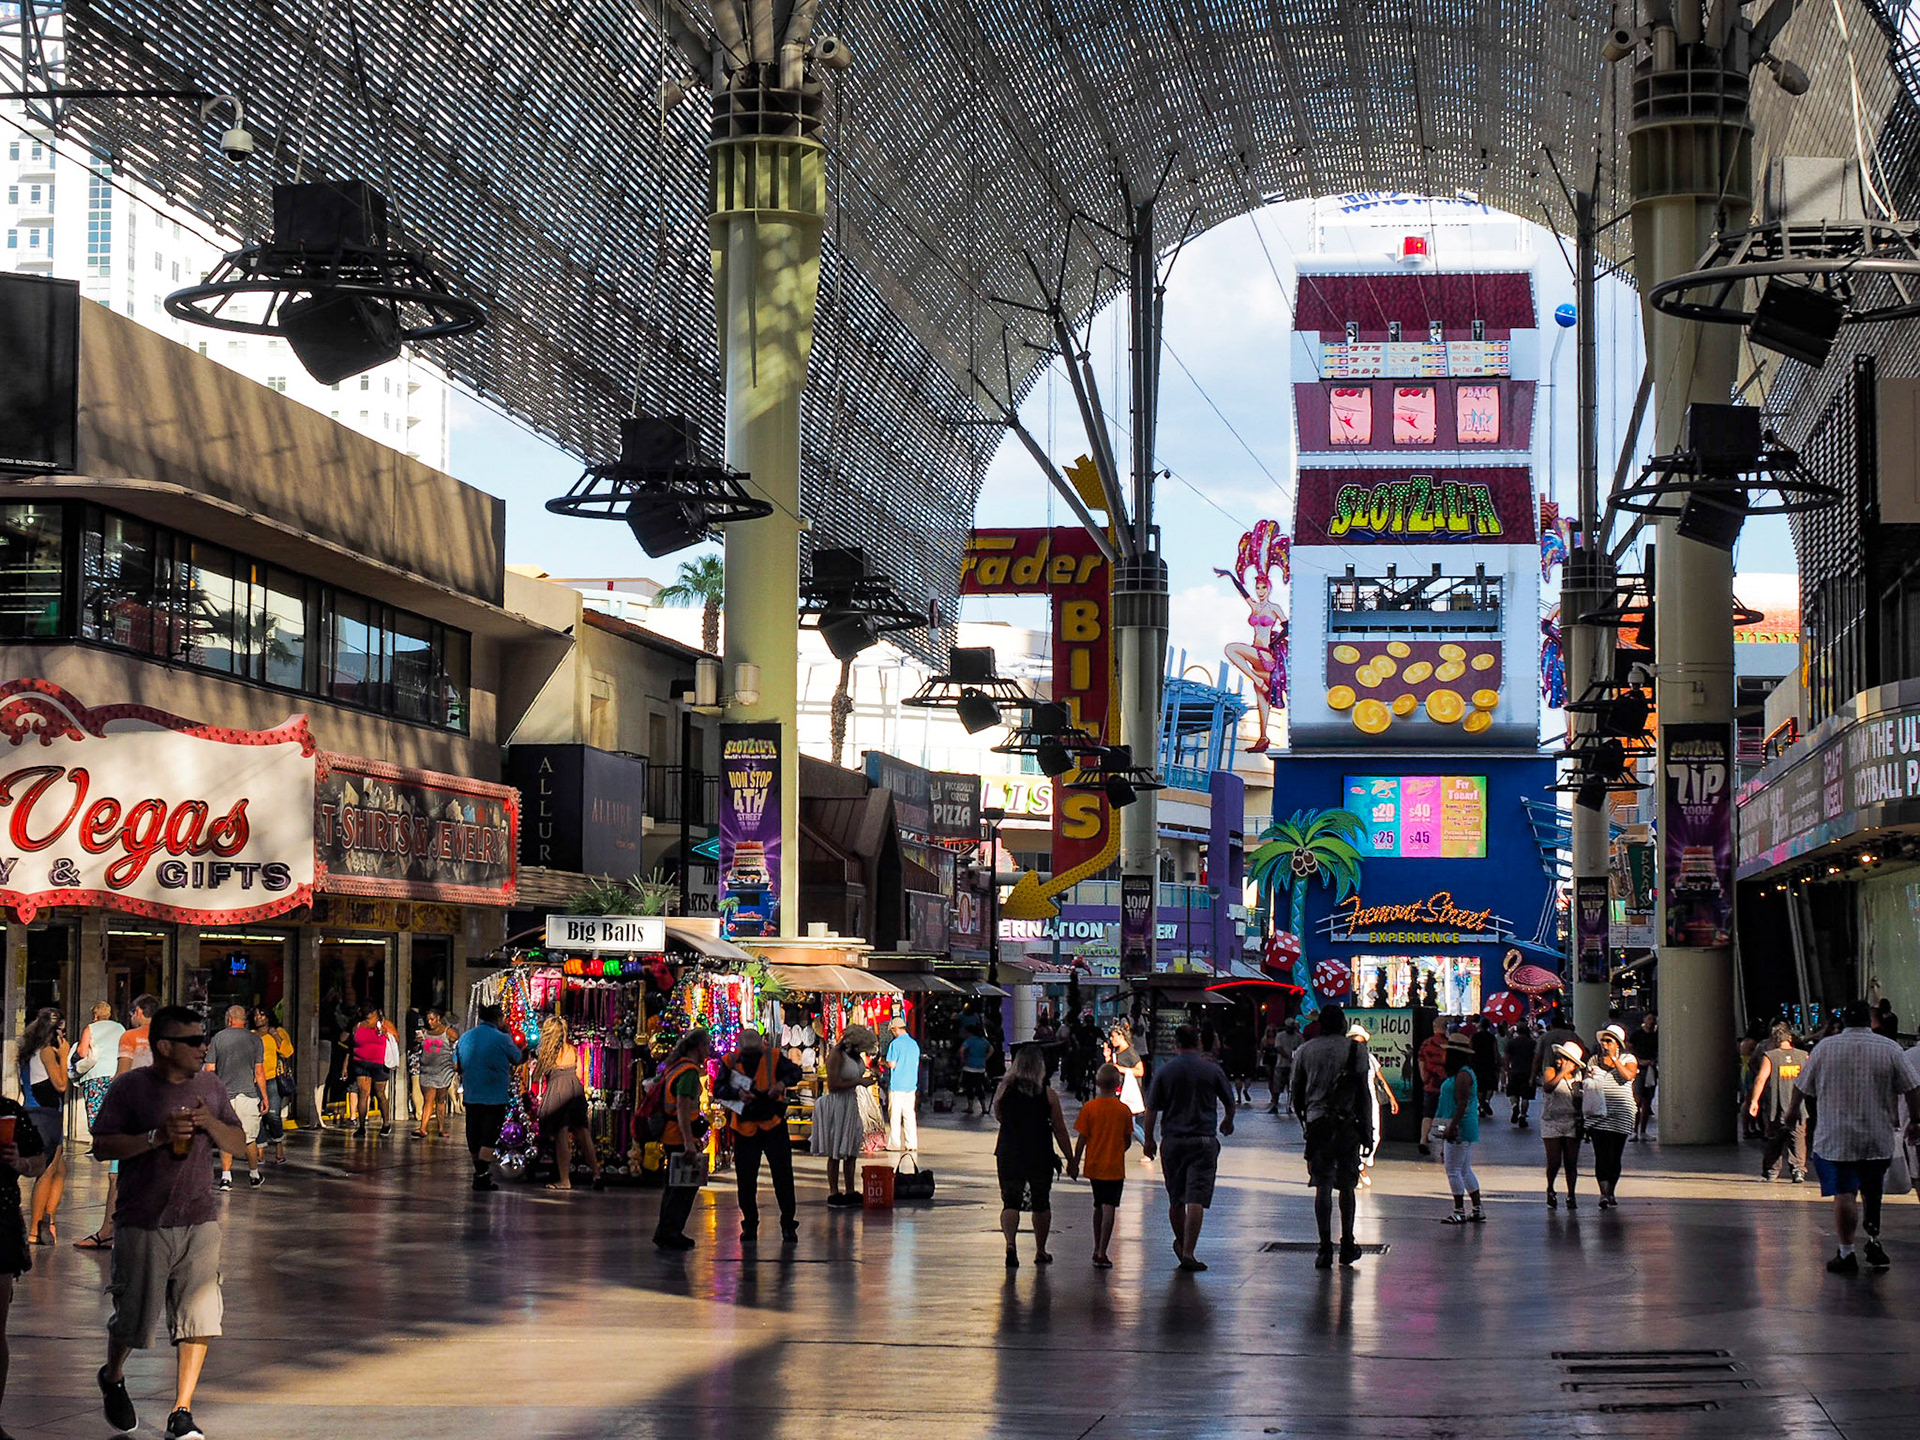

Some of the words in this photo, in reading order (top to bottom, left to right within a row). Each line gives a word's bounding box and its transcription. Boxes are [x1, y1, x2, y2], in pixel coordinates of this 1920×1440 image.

[1466, 415, 1489, 431] BAR
[1327, 475, 1503, 536] SLOTZILLA
[1870, 720, 1894, 759] THE
[1898, 714, 1920, 755] UL
[728, 771, 748, 788] NON
[750, 771, 772, 788] STOP
[945, 781, 975, 793] PICCADILLY
[734, 788, 768, 813] 4TH
[950, 792, 969, 802] CIRCUS
[737, 813, 762, 821] STREET
[934, 804, 971, 827] PIZZA
[1372, 803, 1395, 817] $20
[1409, 803, 1431, 817] $40
[0, 765, 249, 890] Vegas
[322, 803, 412, 855] T-SHIRTS
[433, 820, 507, 865] JEWELRY
[1373, 830, 1394, 844] $25
[1410, 831, 1430, 844] $45
[48, 857, 81, 887] &
[156, 860, 291, 891] GIFTS
[1125, 895, 1151, 909] JOIN
[1127, 909, 1146, 919] THE
[1340, 895, 1423, 938] Fremont
[1421, 891, 1491, 931] Street
[1584, 909, 1601, 922] 4TH
[567, 921, 596, 943] Big
[602, 922, 644, 942] Balls
[998, 919, 1121, 939] ERNATION
[1156, 924, 1178, 939] ERY
[1369, 932, 1460, 944] EXPERIENCE
[1381, 1014, 1411, 1035] HOLO
[867, 1186, 883, 1197] DO
